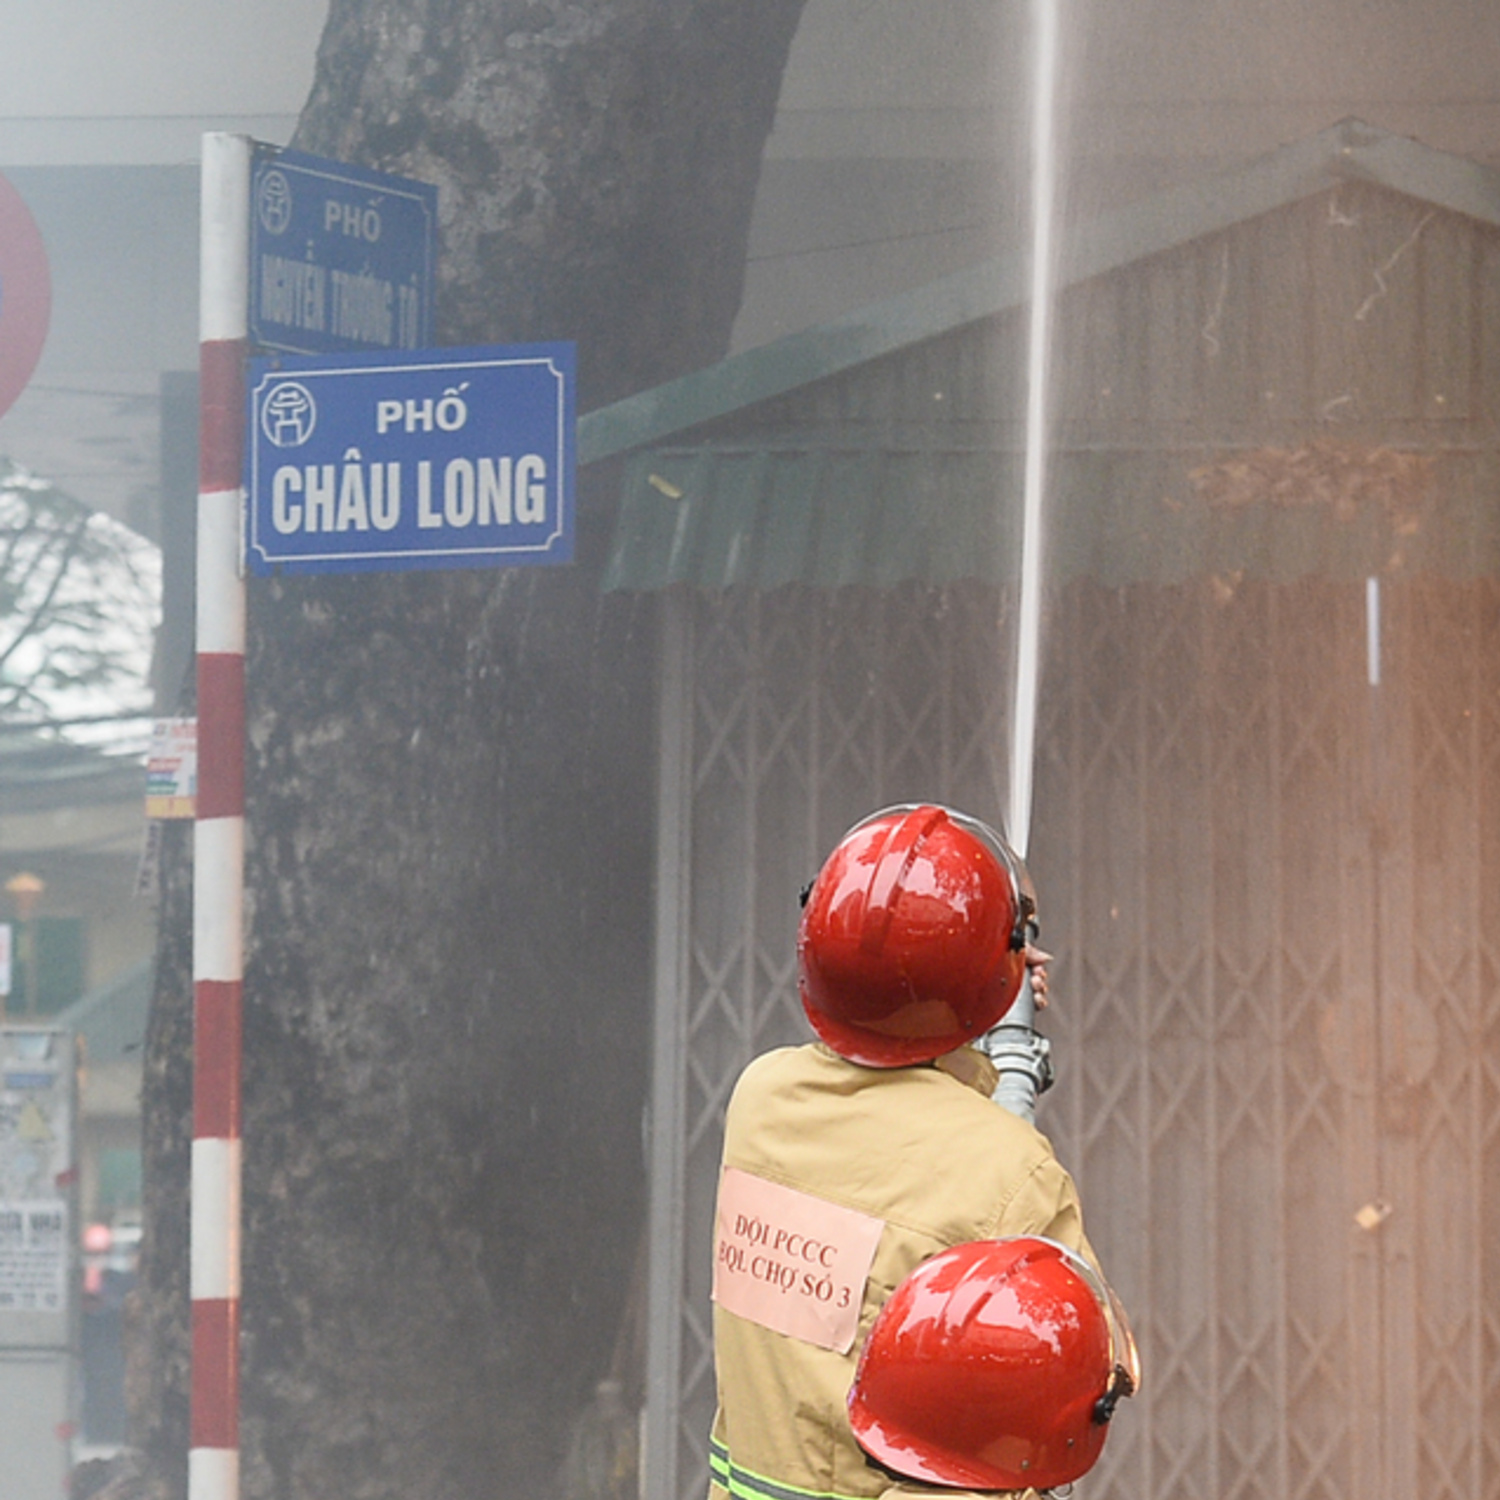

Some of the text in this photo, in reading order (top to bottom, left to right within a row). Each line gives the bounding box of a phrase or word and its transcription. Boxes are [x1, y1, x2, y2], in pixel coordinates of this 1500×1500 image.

[324, 196, 385, 243] PHỐ
[376, 382, 470, 434] PHỐ
[271, 447, 546, 535] CHÂU LONG
[734, 1213, 838, 1269] ĐỘI PCCC
[751, 1256, 800, 1294] CHỢ
[836, 1286, 852, 1309] 3
